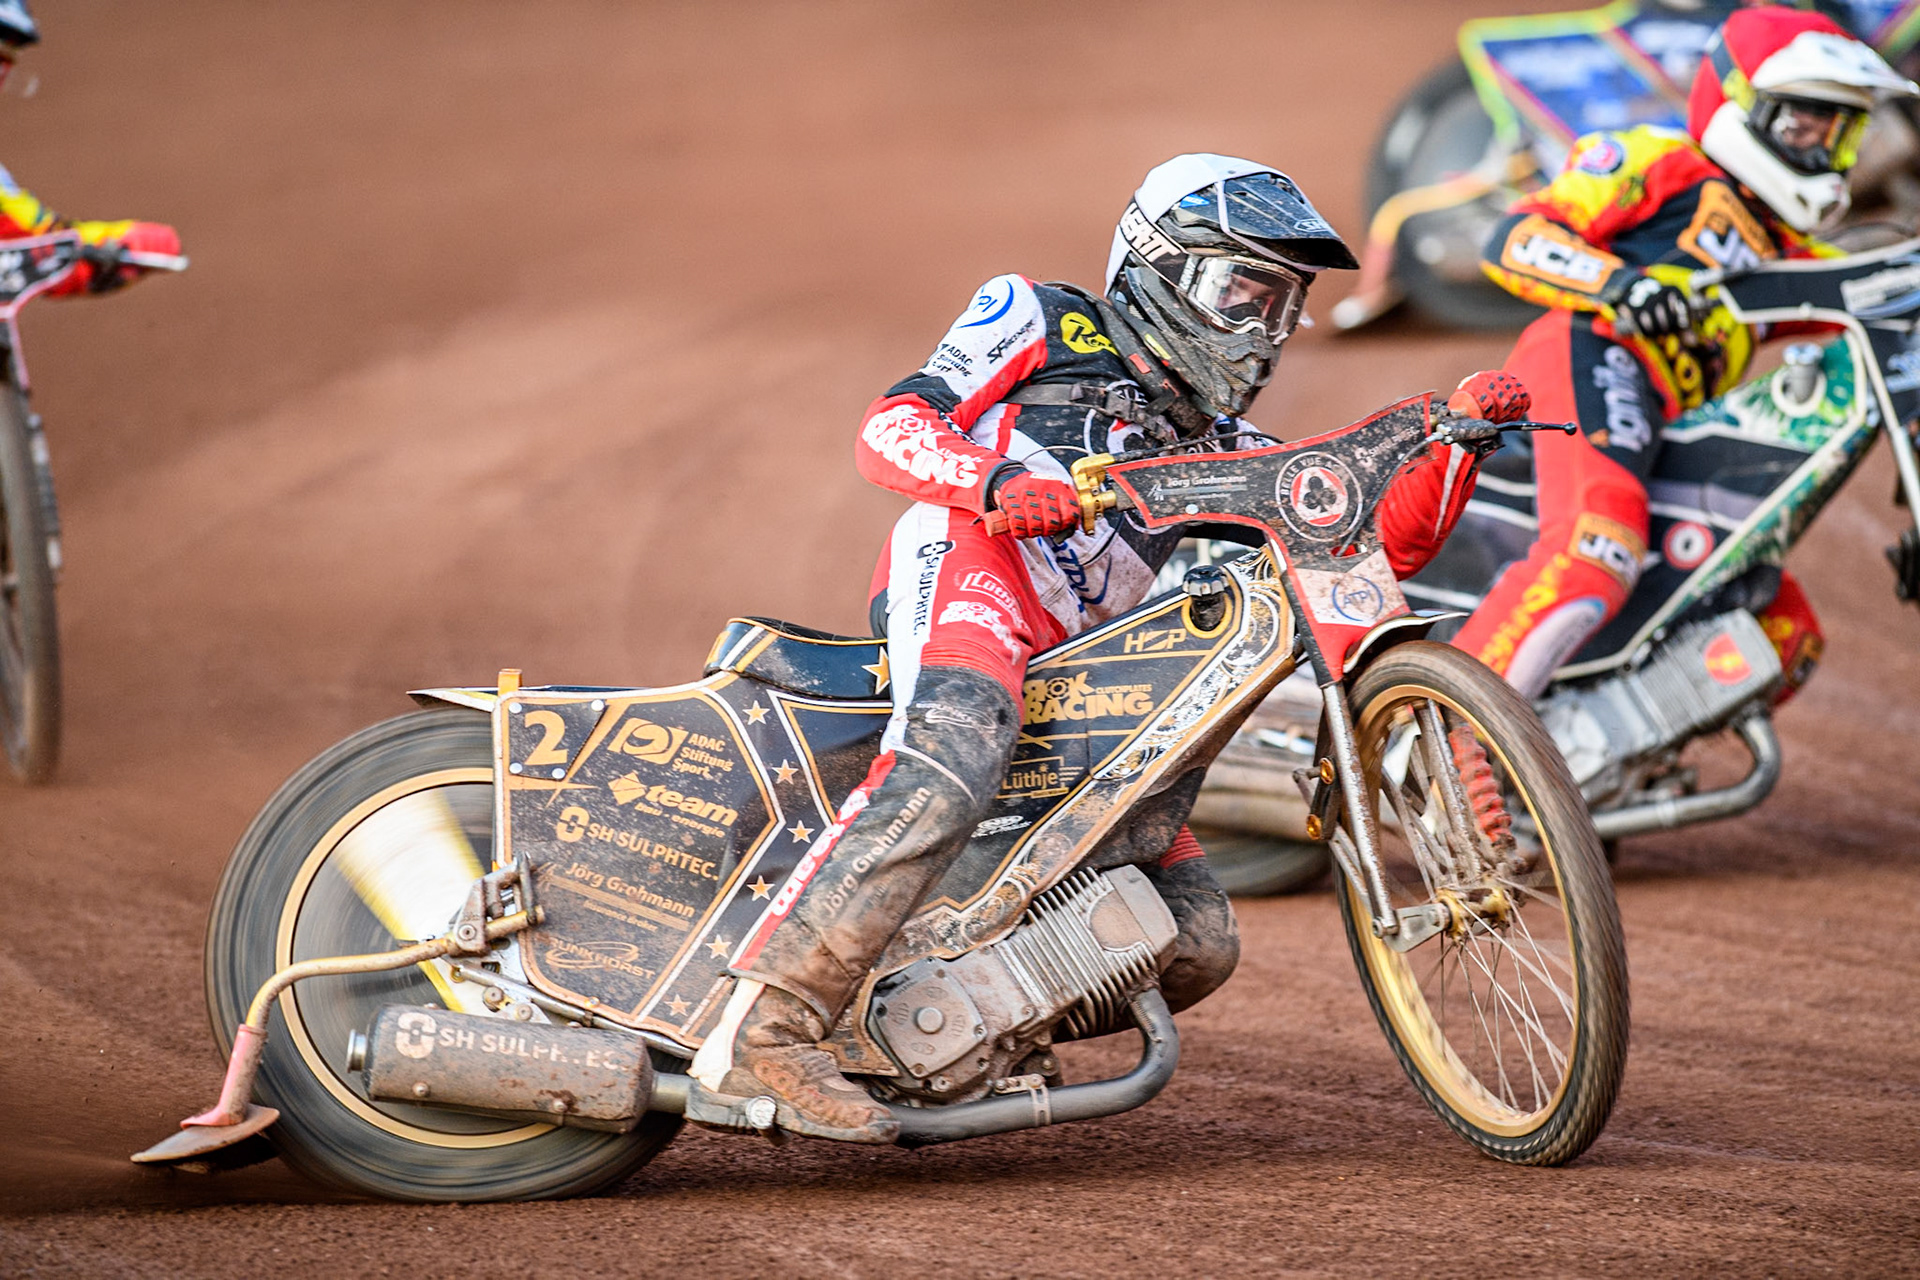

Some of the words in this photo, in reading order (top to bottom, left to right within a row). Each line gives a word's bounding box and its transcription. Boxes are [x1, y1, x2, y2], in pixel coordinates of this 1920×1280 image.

[1511, 235, 1605, 283] JCB
[947, 346, 973, 366] ADAC
[862, 412, 979, 489] RACING
[1024, 692, 1154, 725] RACING
[524, 711, 567, 765] 2
[688, 733, 726, 752] ADAC
[672, 758, 711, 777] Sport
[681, 747, 734, 772] Stiftung
[1001, 763, 1058, 790] Lüthje
[634, 802, 663, 816] bau
[671, 814, 726, 838] energie
[645, 785, 738, 827] team
[588, 821, 615, 843] SH
[616, 831, 720, 881] SULPHTEC.
[822, 872, 858, 918] Jörg
[852, 786, 932, 873] Grohmann
[565, 862, 604, 888] Jörg
[606, 875, 695, 918] Grohmann
[439, 1028, 475, 1051] SH
